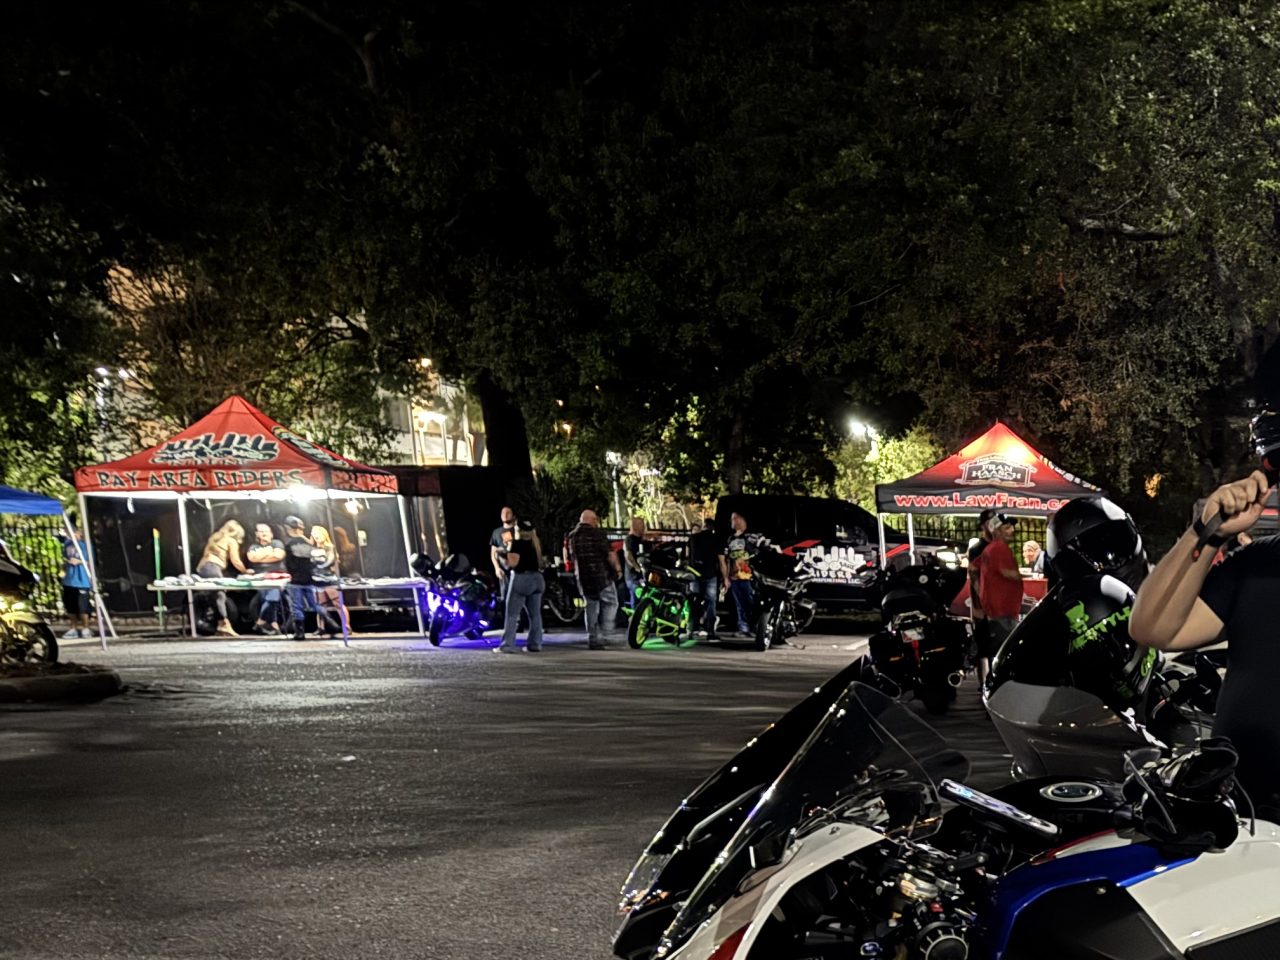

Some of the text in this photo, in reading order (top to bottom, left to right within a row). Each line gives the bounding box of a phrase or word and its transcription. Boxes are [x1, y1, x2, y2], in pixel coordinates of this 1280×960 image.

[982, 464, 1013, 473] FRAN
[96, 469, 306, 488] BAY AREA RIDERS
[894, 492, 1070, 510] www.LawFran.co
